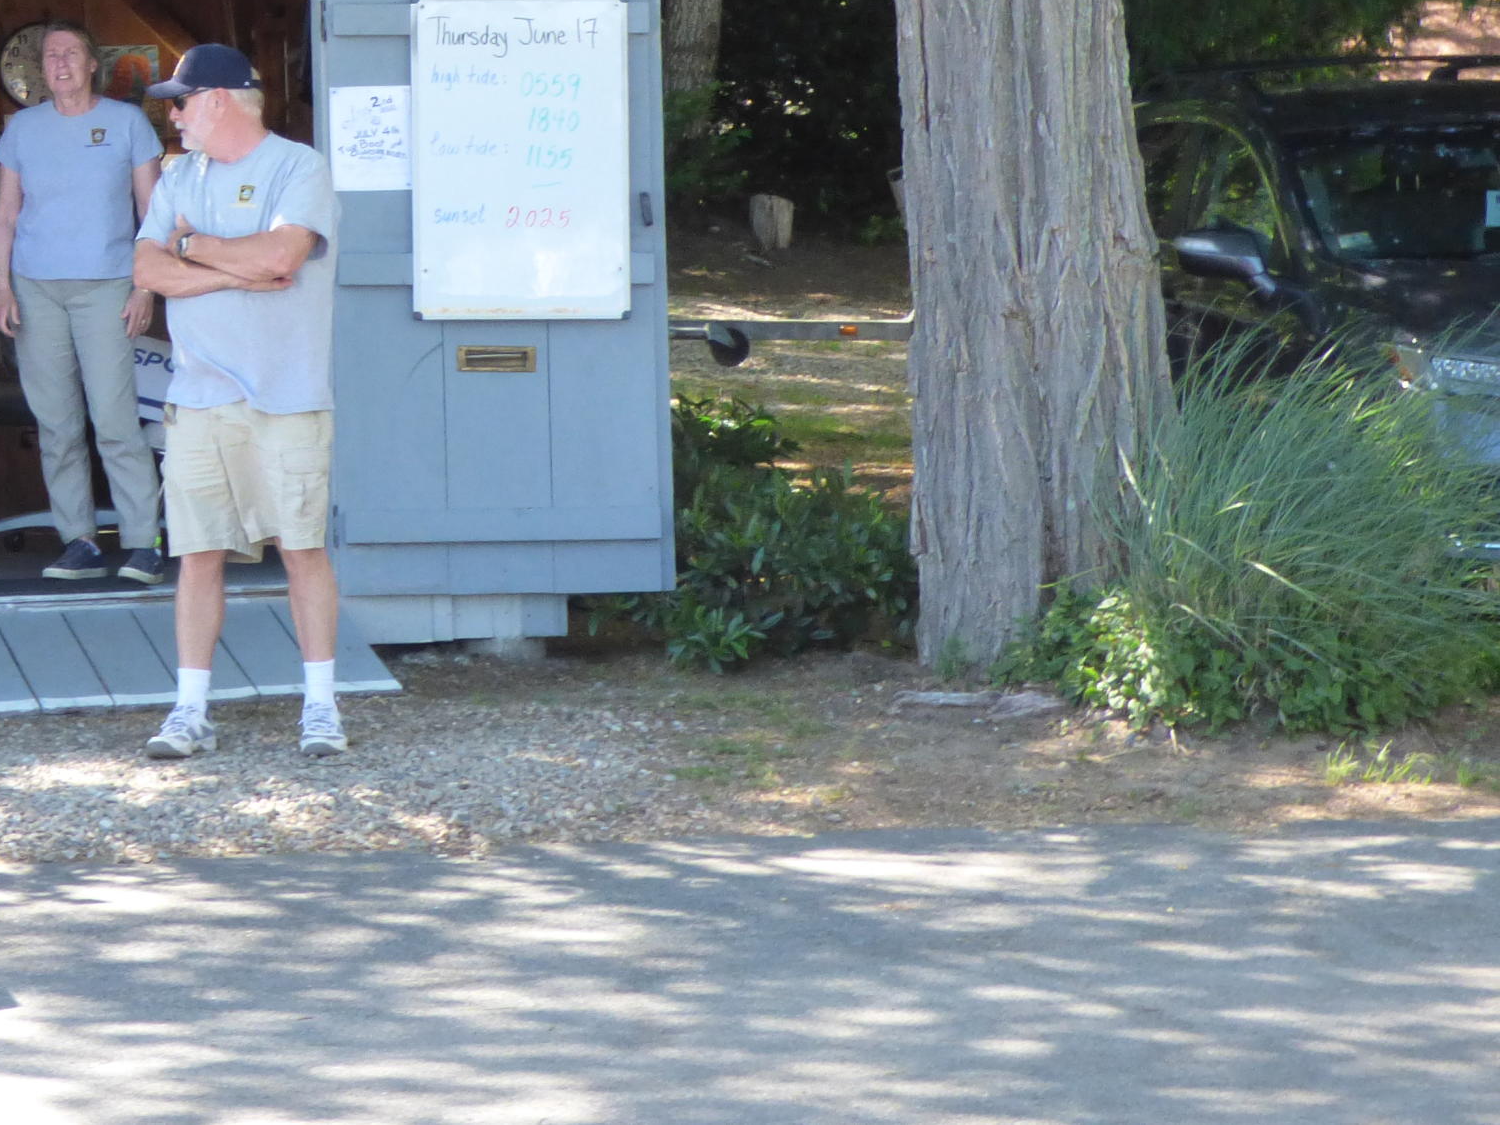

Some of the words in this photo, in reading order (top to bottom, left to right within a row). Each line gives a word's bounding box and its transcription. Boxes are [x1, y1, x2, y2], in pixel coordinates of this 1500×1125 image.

[427, 16, 508, 58] Thursday
[513, 17, 568, 45] June
[576, 17, 598, 48] 17
[430, 63, 460, 91] high
[520, 72, 581, 99] 0559
[528, 106, 581, 133] 1840
[526, 144, 573, 169] 1155
[434, 203, 486, 225] sunset
[505, 205, 573, 228] 2025
